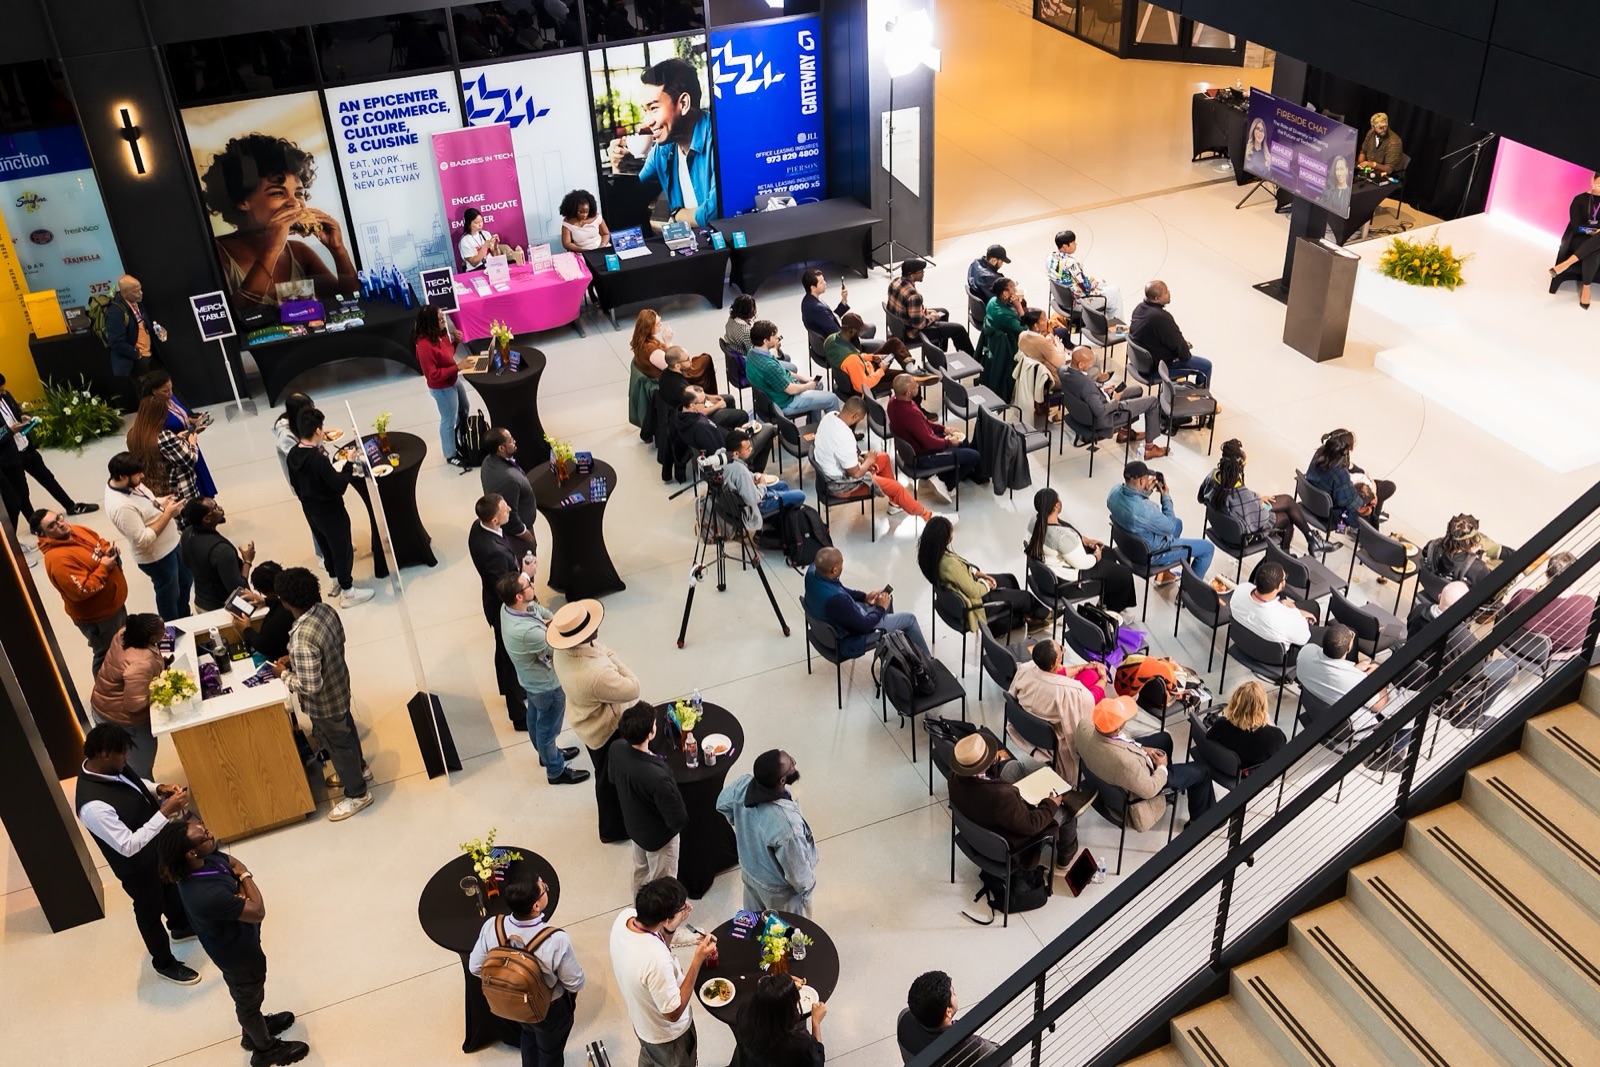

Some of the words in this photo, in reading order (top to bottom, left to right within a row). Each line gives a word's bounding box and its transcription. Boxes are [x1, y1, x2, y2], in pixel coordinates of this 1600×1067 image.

[799, 54, 818, 115] GATEWAY
[338, 99, 361, 114] AN
[363, 88, 439, 110] EPICENTER
[341, 114, 360, 127] OF
[362, 101, 451, 124] COMMERCE,
[1276, 108, 1307, 128] FIRESIDE
[1307, 121, 1328, 136] CHAT
[344, 121, 410, 140] CULTURE,
[1292, 127, 1309, 140] Diversity
[347, 143, 358, 154] &
[360, 133, 419, 152] CUISINE
[1272, 144, 1293, 157] ASHLEY
[449, 156, 485, 168] BADDIES
[493, 152, 514, 160] TECH
[755, 150, 774, 159] OFFICE
[773, 146, 795, 156] LEASING
[766, 154, 782, 164] 973
[781, 151, 798, 162] 829
[798, 148, 819, 159] 4800
[1271, 155, 1289, 168] RYDER
[1299, 156, 1326, 173] SHANNON
[352, 171, 359, 180] &
[360, 168, 384, 179] PLAY
[386, 165, 399, 175] AT
[401, 162, 419, 172] THE
[1300, 170, 1326, 185] MORALES
[354, 180, 375, 191] NEW
[377, 172, 421, 187] GATEWAY
[757, 182, 774, 191] RETAIL
[774, 178, 796, 188] LEASING
[788, 182, 810, 192] 6900
[451, 193, 486, 206] ENGAGE
[480, 199, 519, 213] EDUCATE
[451, 214, 495, 229] EMER
[89, 281, 111, 294] 375
[425, 277, 450, 288] TECH
[427, 286, 453, 298] ALLEY
[200, 310, 227, 322] TABLE
